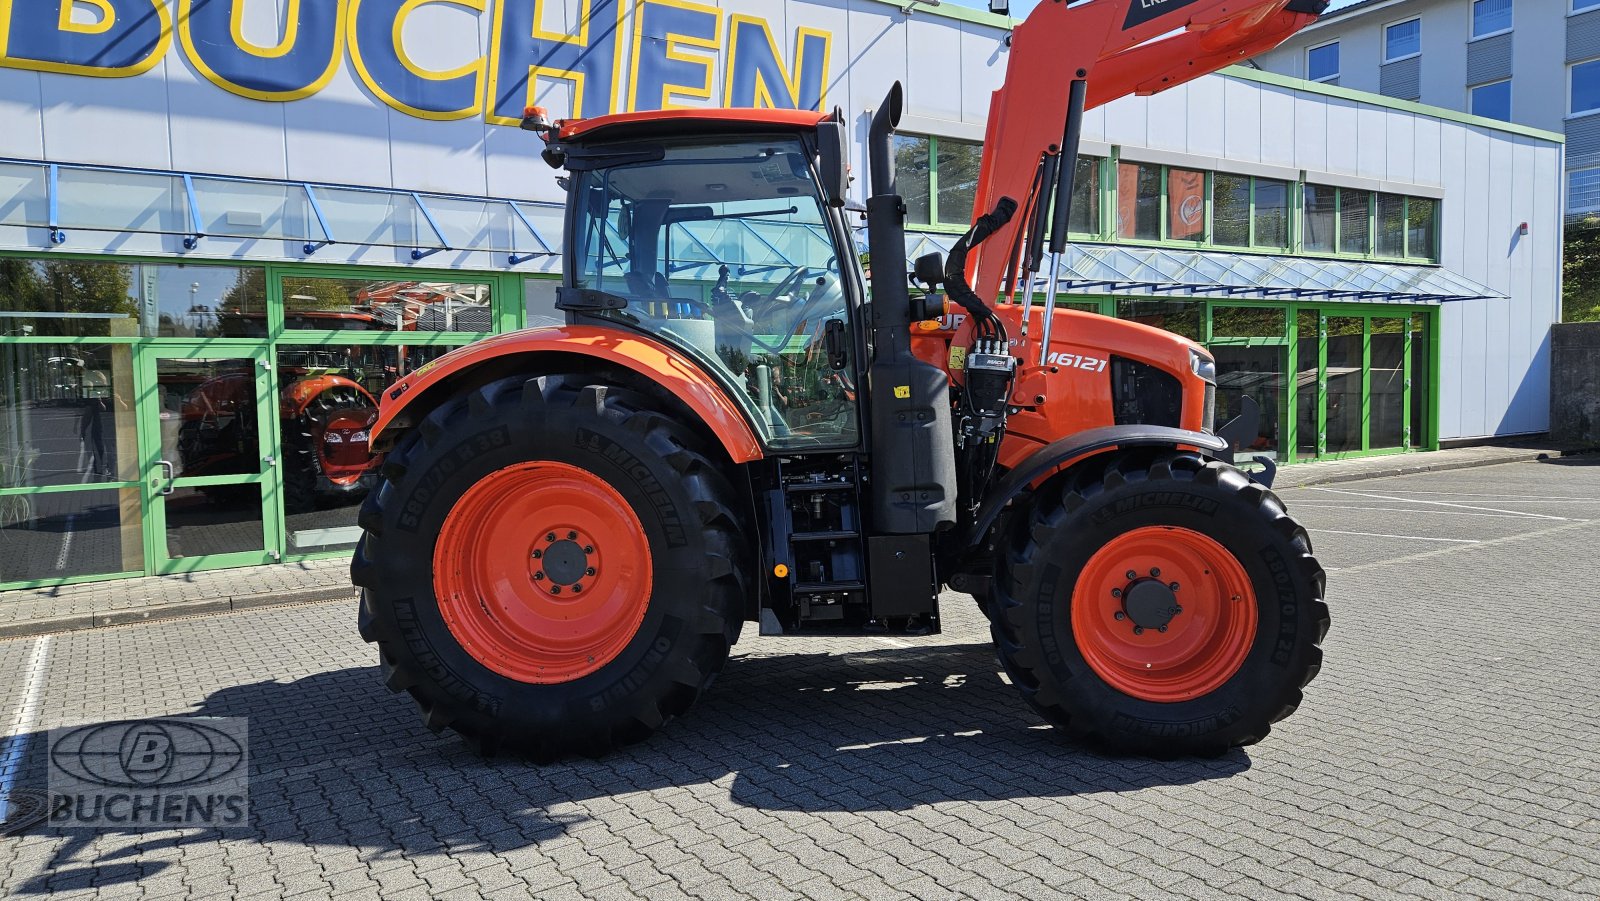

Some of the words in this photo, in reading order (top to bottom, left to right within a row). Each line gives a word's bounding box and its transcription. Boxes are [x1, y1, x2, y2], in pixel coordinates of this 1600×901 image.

[1048, 351, 1107, 372] M6121
[400, 458, 456, 528] 580/70
[476, 429, 505, 451] 38
[602, 442, 687, 546] MICHELIN
[1115, 492, 1218, 513] MICHELIN
[1264, 550, 1297, 616] 480/70
[393, 601, 477, 698] MICHELIN
[1038, 581, 1061, 665] OMNIBIB
[1275, 639, 1293, 662] 28
[1281, 622, 1296, 634] R
[588, 635, 672, 712] OMNIBIB
[1112, 714, 1218, 738] MICHELIN
